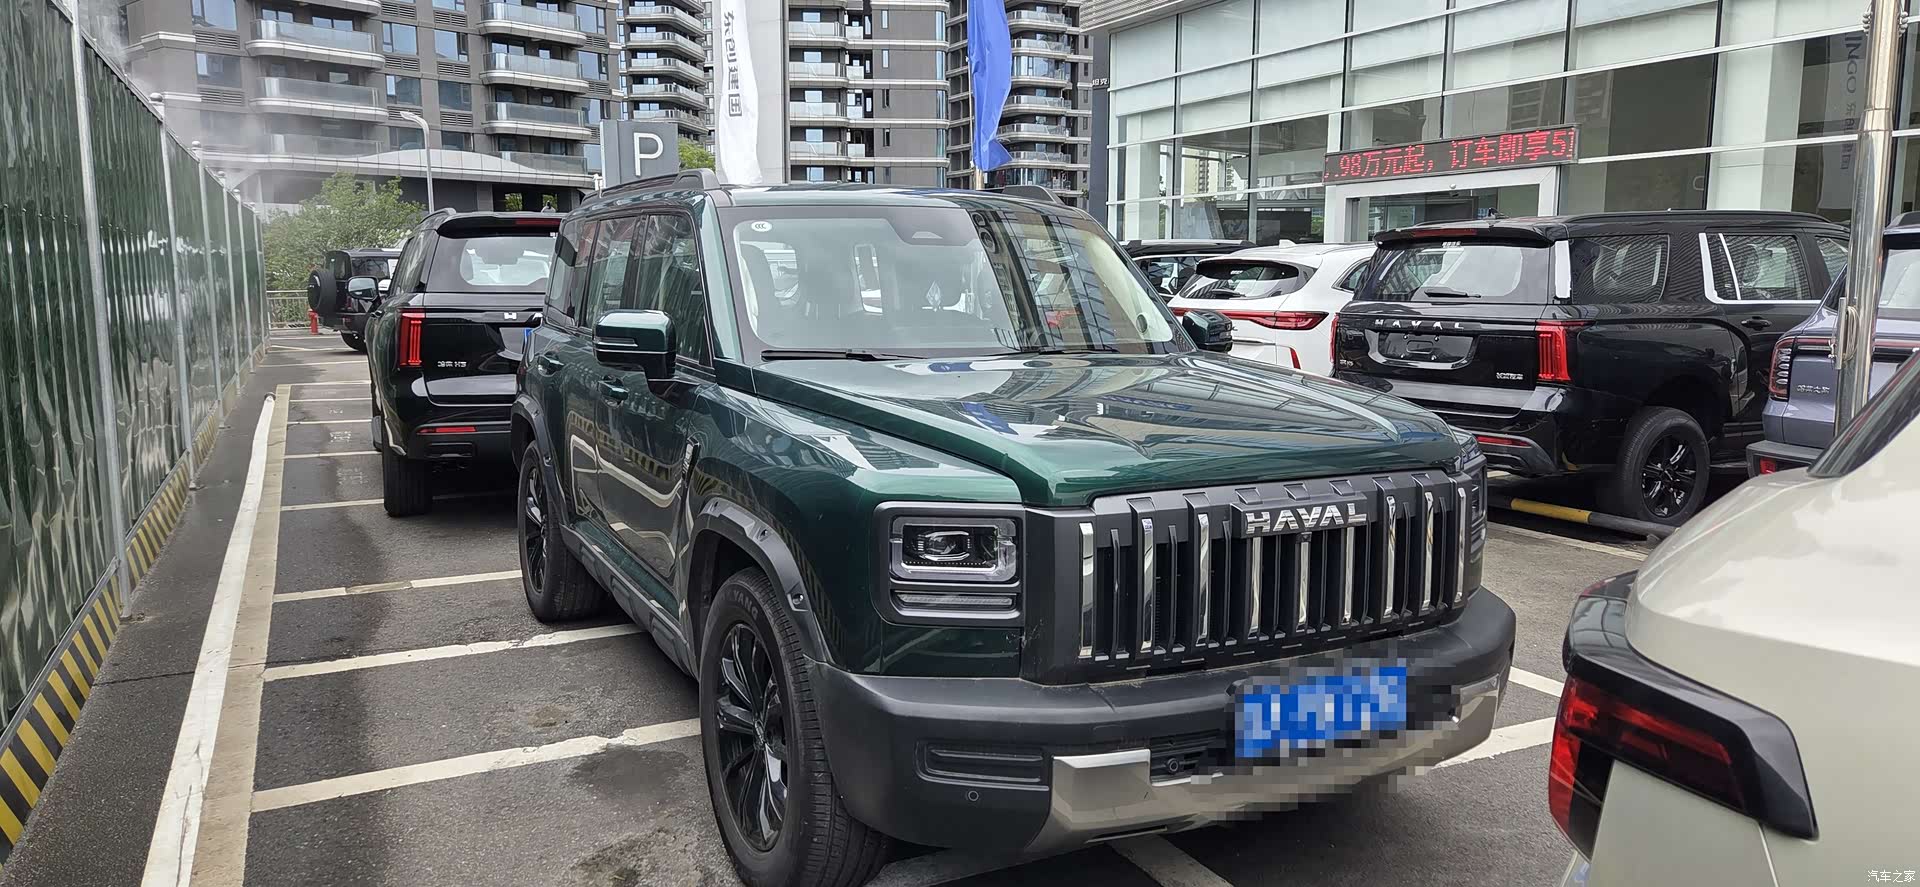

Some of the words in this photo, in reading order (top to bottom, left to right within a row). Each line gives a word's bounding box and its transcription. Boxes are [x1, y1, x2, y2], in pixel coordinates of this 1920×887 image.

[724, 10, 743, 117] 东创建国
[633, 132, 664, 177] P
[1374, 318, 1465, 331] HAVAL
[1245, 502, 1368, 535] HAVAL
